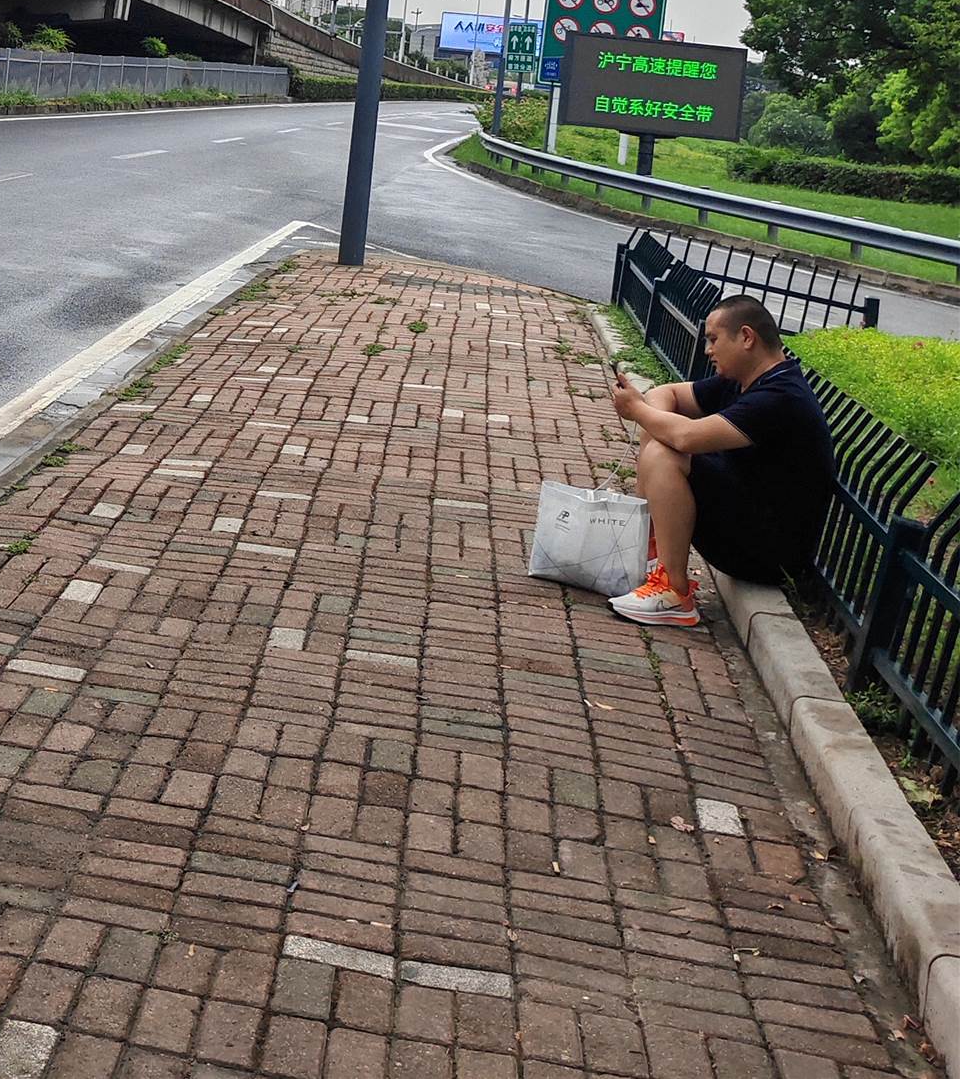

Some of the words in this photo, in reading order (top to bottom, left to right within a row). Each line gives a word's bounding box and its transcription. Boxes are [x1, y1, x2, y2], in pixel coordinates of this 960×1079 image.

[597, 51, 719, 81] 沪宁高速提醒您
[594, 95, 714, 123] 自觉系好安全带
[590, 517, 627, 527] WHITE
